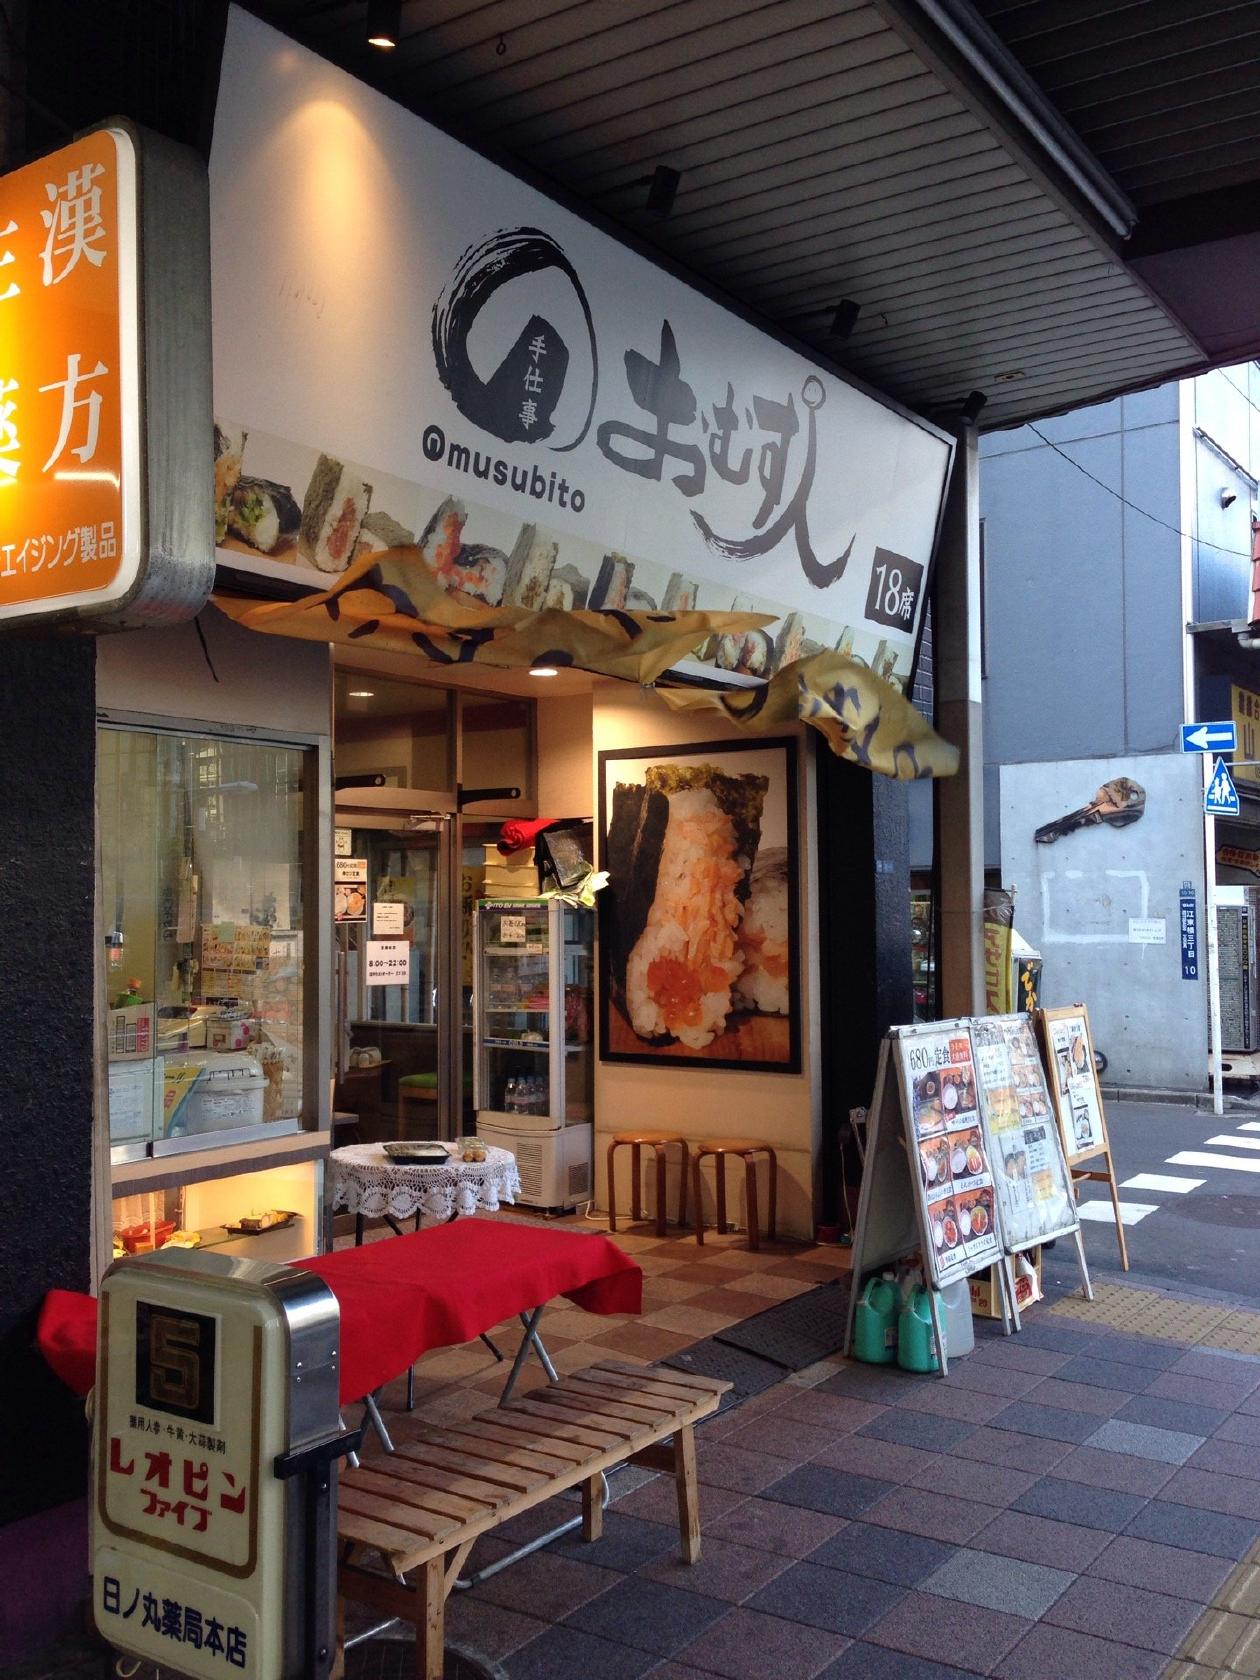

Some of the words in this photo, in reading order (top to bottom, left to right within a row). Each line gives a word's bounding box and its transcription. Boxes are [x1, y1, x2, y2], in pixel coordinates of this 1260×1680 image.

[38, 162, 110, 474] 漢方
[518, 334, 548, 431] 手仕事
[874, 563, 915, 621] 18席
[1184, 965, 1196, 975] 10
[1186, 910, 1195, 958] 江東橋三丁目
[110, 1437, 246, 1515] レオピン
[103, 1575, 248, 1669] 日ノ丸薬局本店
